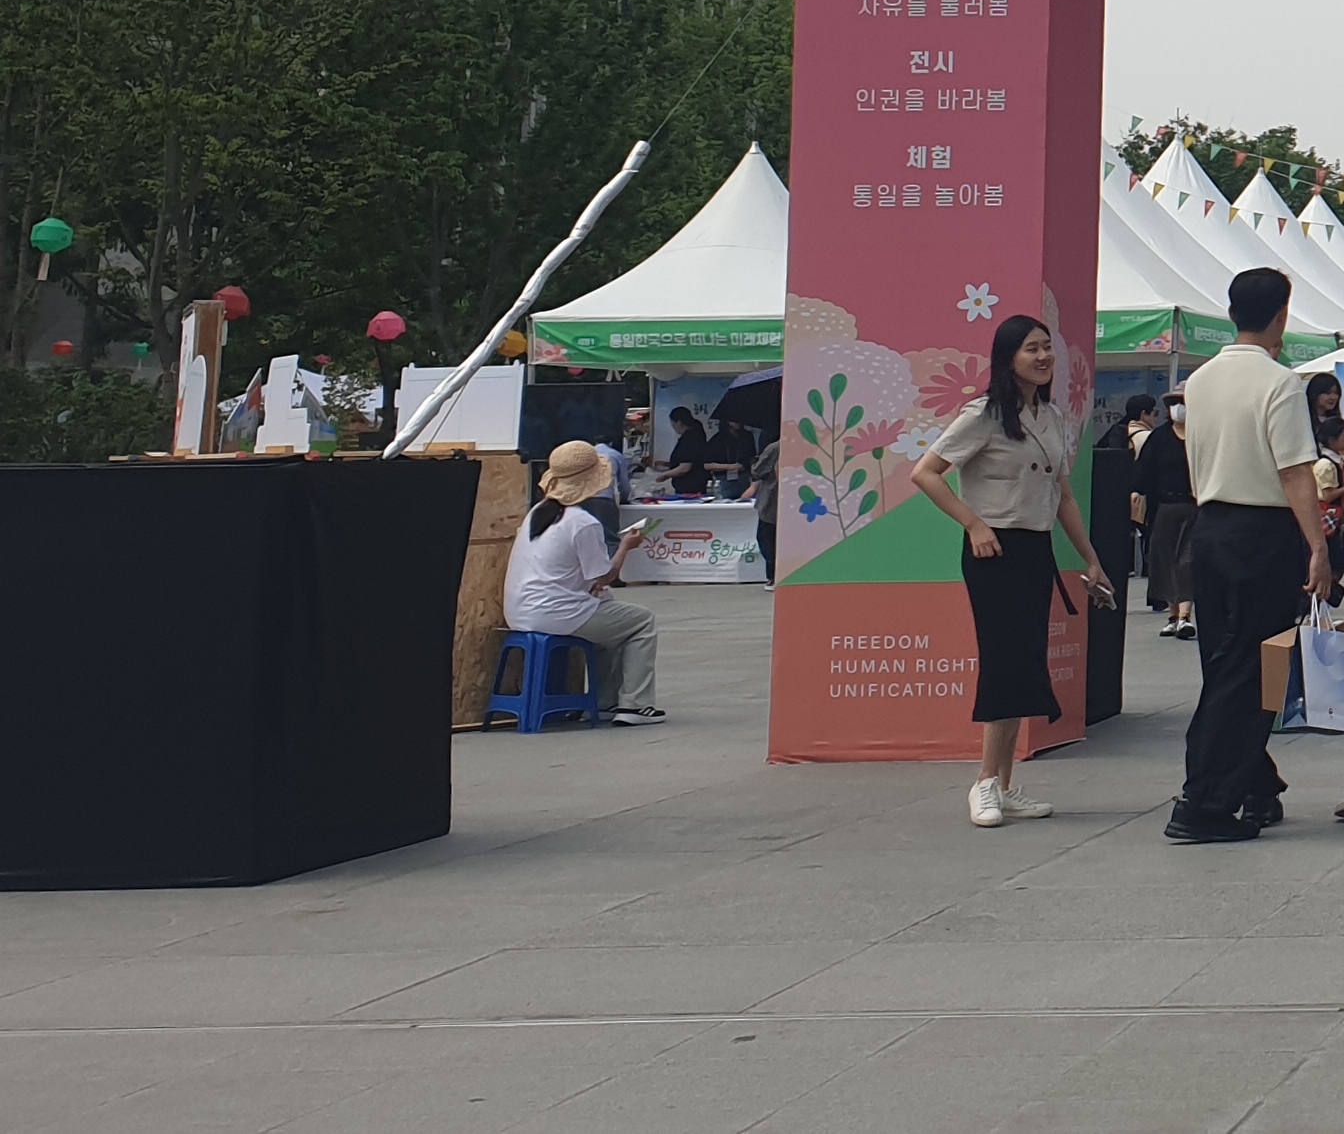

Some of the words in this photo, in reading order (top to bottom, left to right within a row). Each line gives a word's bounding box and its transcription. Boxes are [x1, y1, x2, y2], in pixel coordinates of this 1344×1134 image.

[908, 49, 955, 74] 전시
[855, 88, 925, 112] 인권을
[937, 87, 1007, 111] 바라봄
[906, 144, 952, 169] 체험
[852, 183, 922, 208] 통일을
[934, 183, 1005, 207] 놀아봄
[831, 634, 930, 650] FREEDOM
[830, 658, 906, 674] HUMAN
[916, 657, 978, 673] RIGHT
[829, 682, 965, 698] UNIFICATION
